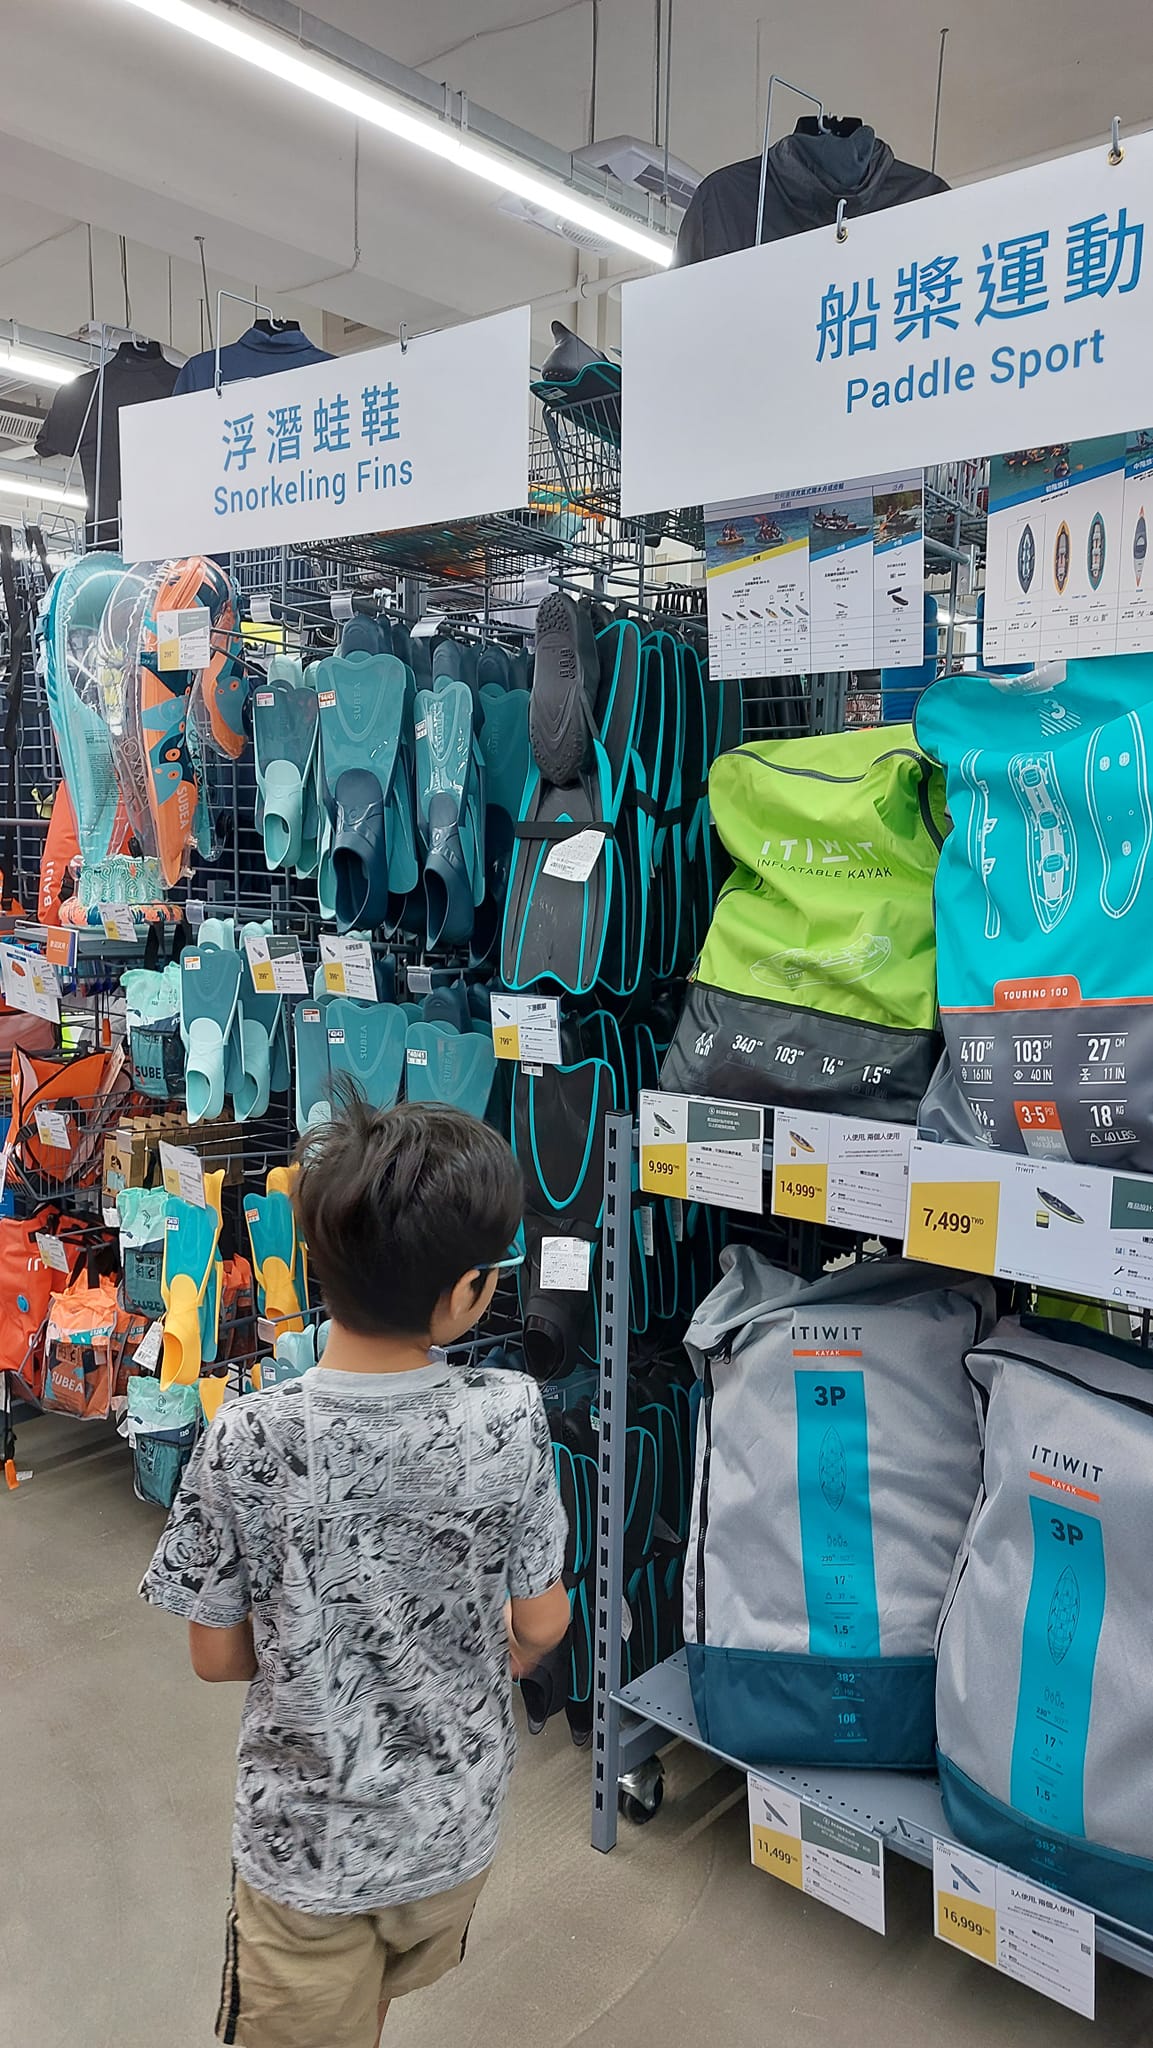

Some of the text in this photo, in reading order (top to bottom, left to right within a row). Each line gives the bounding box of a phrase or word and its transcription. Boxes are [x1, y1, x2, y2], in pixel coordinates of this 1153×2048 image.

[815, 207, 1145, 363] 船槳運動
[847, 329, 1105, 414] Paddle Sport
[222, 381, 400, 473] 浮潛蛙鞋
[213, 457, 413, 517] Snorkeling Fins
[353, 681, 361, 720] SUBEA
[176, 786, 189, 830] SUBEA
[757, 858, 893, 879] INFLATABLE KAYAK
[1003, 987, 1069, 1000] TOURING 100
[360, 1025, 368, 1060] SUBEA
[732, 1034, 757, 1054] 340
[960, 1041, 985, 1063] 410
[1014, 1040, 1042, 1063] 103
[1087, 1038, 1126, 1062] 27 CM
[774, 1045, 798, 1064] 103
[135, 1065, 165, 1080] SUBE
[822, 1057, 836, 1075] 14
[862, 1065, 883, 1084] 1.5
[1030, 1068, 1042, 1081] 40
[1104, 1066, 1125, 1080] 11 IN
[1021, 1106, 1046, 1124] 3-5
[1090, 1105, 1125, 1127] 18 KG
[648, 1160, 673, 1175] 9,999
[780, 1181, 815, 1199] 14,999
[922, 1208, 985, 1234] 7,499 TWD
[791, 1326, 863, 1341] ITIWIT
[51, 1370, 84, 1394] SUBEA
[814, 1385, 846, 1407] 3P
[1031, 1444, 1103, 1483] ITIWIT
[1051, 1479, 1077, 1495] KAYAK
[1050, 1518, 1084, 1546] 3P
[834, 1575, 846, 1585] 17
[833, 1624, 849, 1635] 1.5
[836, 1672, 855, 1684] 382
[1044, 1733, 1056, 1748] 17
[1035, 1785, 1050, 1801] 1.5
[757, 1838, 791, 1865] 11,499
[1035, 1839, 1057, 1854] 382
[943, 1906, 983, 1936] 16,999
